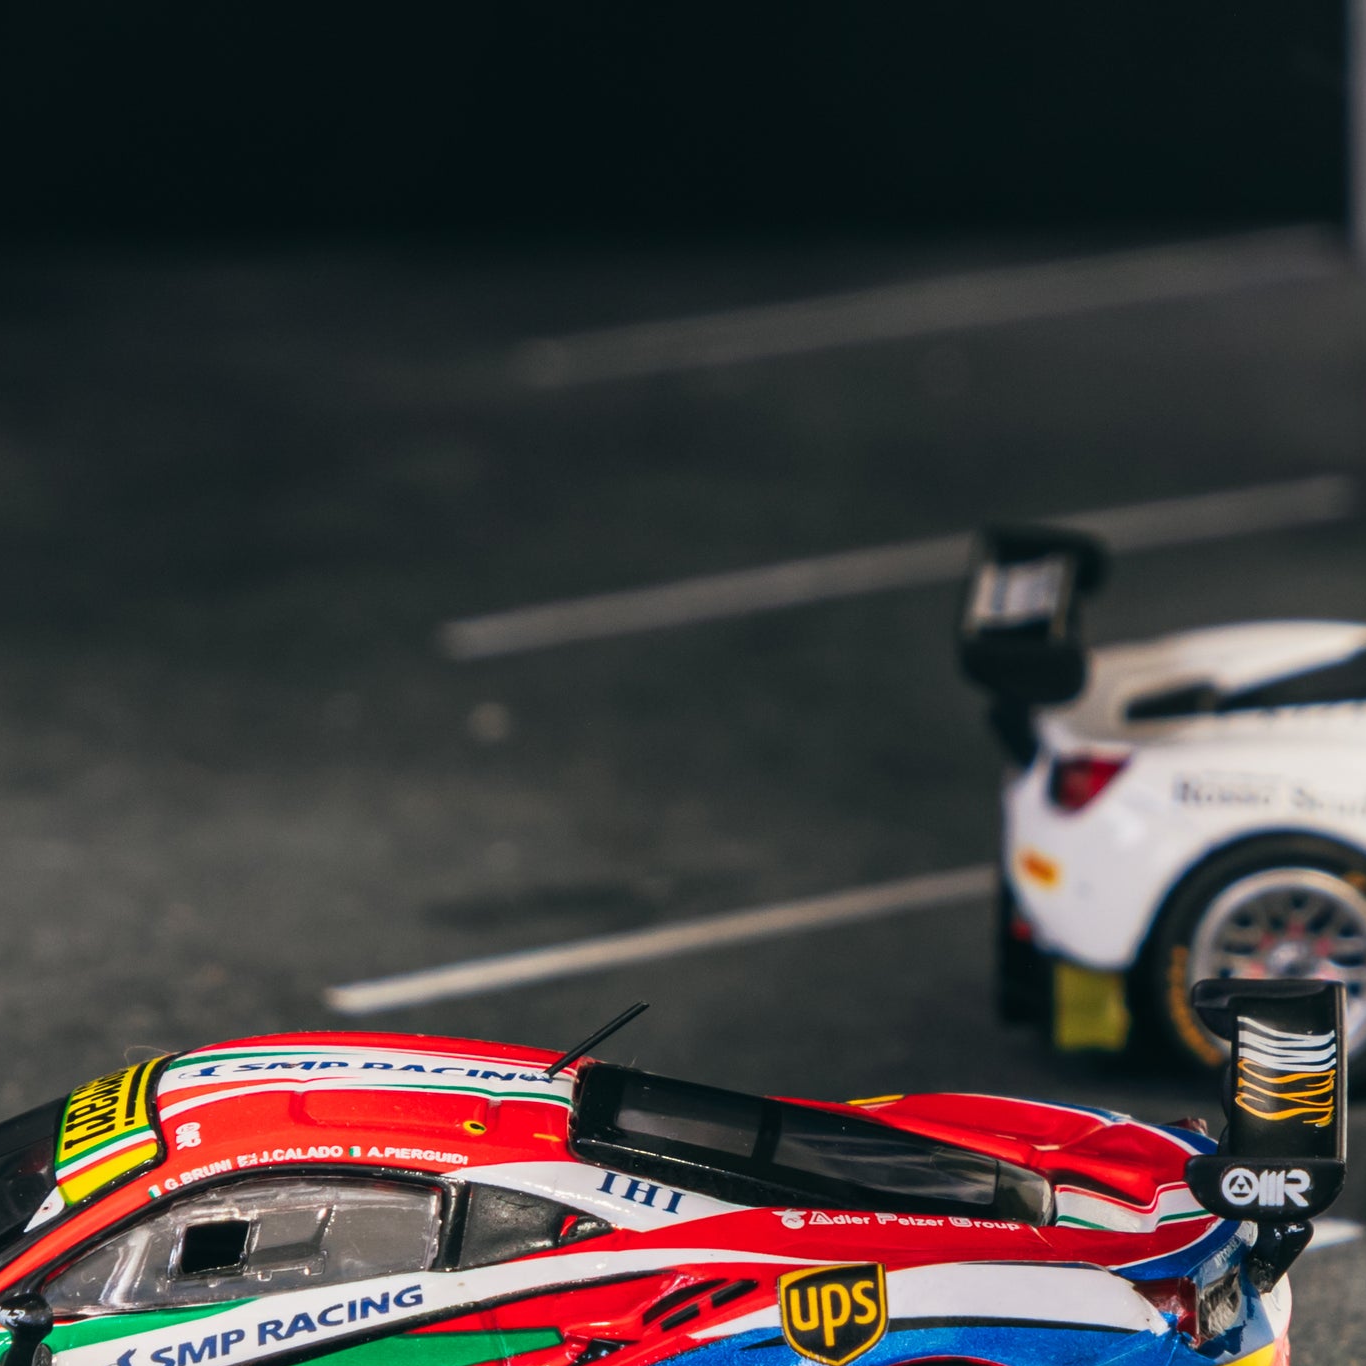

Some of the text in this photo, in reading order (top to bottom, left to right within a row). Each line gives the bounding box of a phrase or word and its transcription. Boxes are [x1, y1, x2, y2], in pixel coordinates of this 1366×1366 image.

[235, 1060, 351, 1073] SMP
[164, 1146, 469, 1190] G.BRUNI J.CALADO A.PIERGUIDI
[596, 1170, 687, 1215] IHI
[807, 1210, 1020, 1232] Adler Pelzer Group
[257, 1284, 424, 1347] RACING
[789, 1279, 878, 1347] ups
